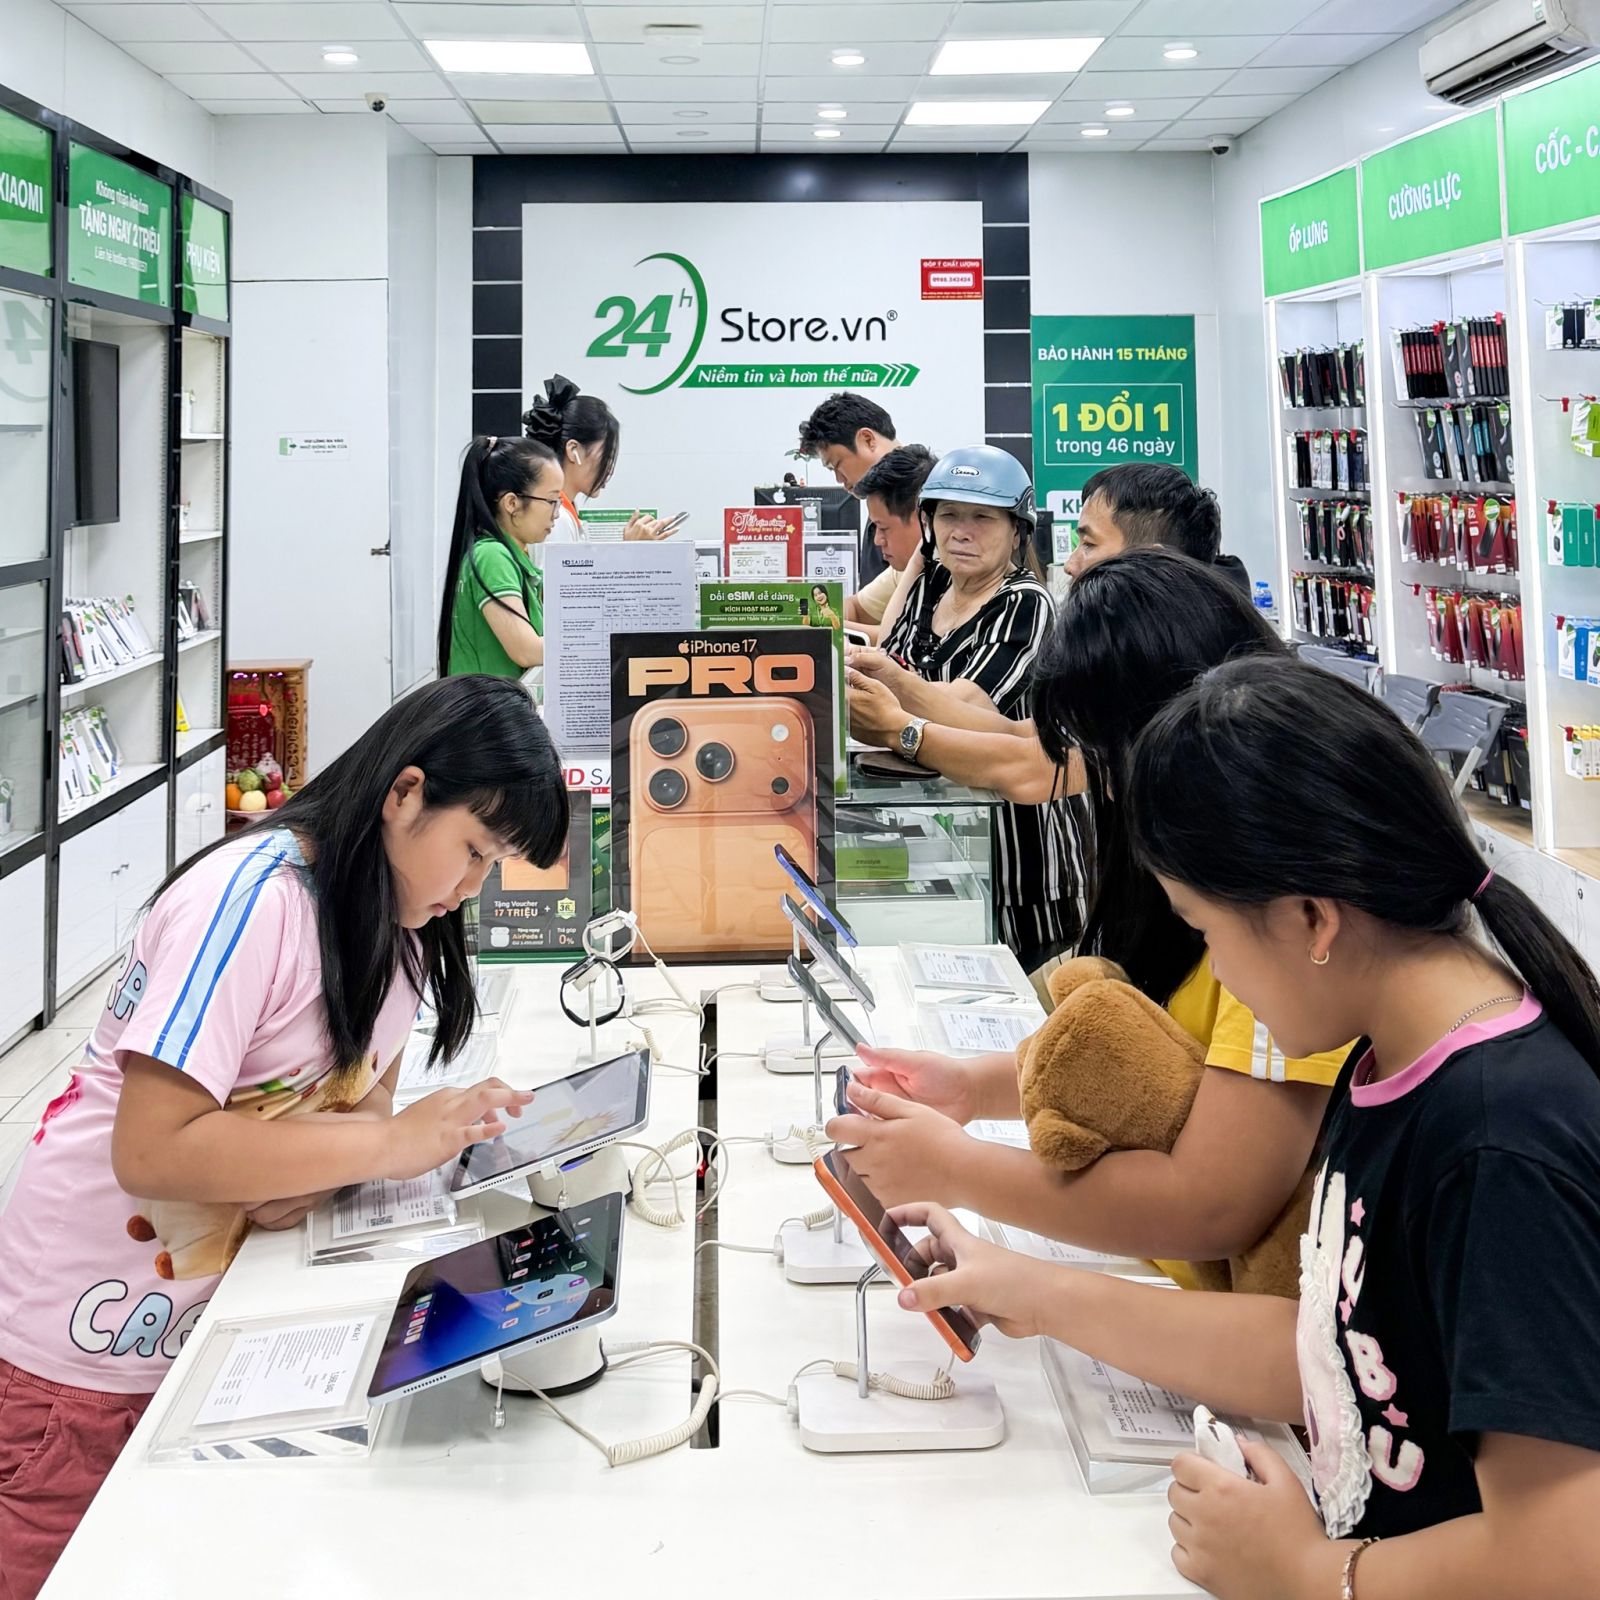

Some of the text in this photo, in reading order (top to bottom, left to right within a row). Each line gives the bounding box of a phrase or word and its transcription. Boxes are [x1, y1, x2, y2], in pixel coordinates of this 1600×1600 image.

[1536, 126, 1571, 173] CỐC
[1586, 125, 1600, 158] C
[0, 171, 43, 214] XIAOMI
[1389, 171, 1462, 220] CƯỜNG LỰC
[79, 200, 107, 237] TẶNG
[108, 213, 131, 244] NGAY
[1289, 222, 1301, 253] ỐP
[1038, 344, 1188, 361] BẢO HÀNH 15 THÁNG
[698, 366, 878, 383] Niềm tin và hơn thế nữa
[1052, 390, 1169, 432] 1 ĐỔI 1
[1056, 437, 1175, 457] trong 46 ngày
[710, 590, 795, 603] Đổi eSIM dễ dàng
[725, 604, 741, 613] KÍCH
[742, 606, 758, 614] HOẠT
[690, 638, 757, 654] iPhone 17
[628, 653, 815, 697] PRO
[495, 907, 538, 918] 17 TRIỆU
